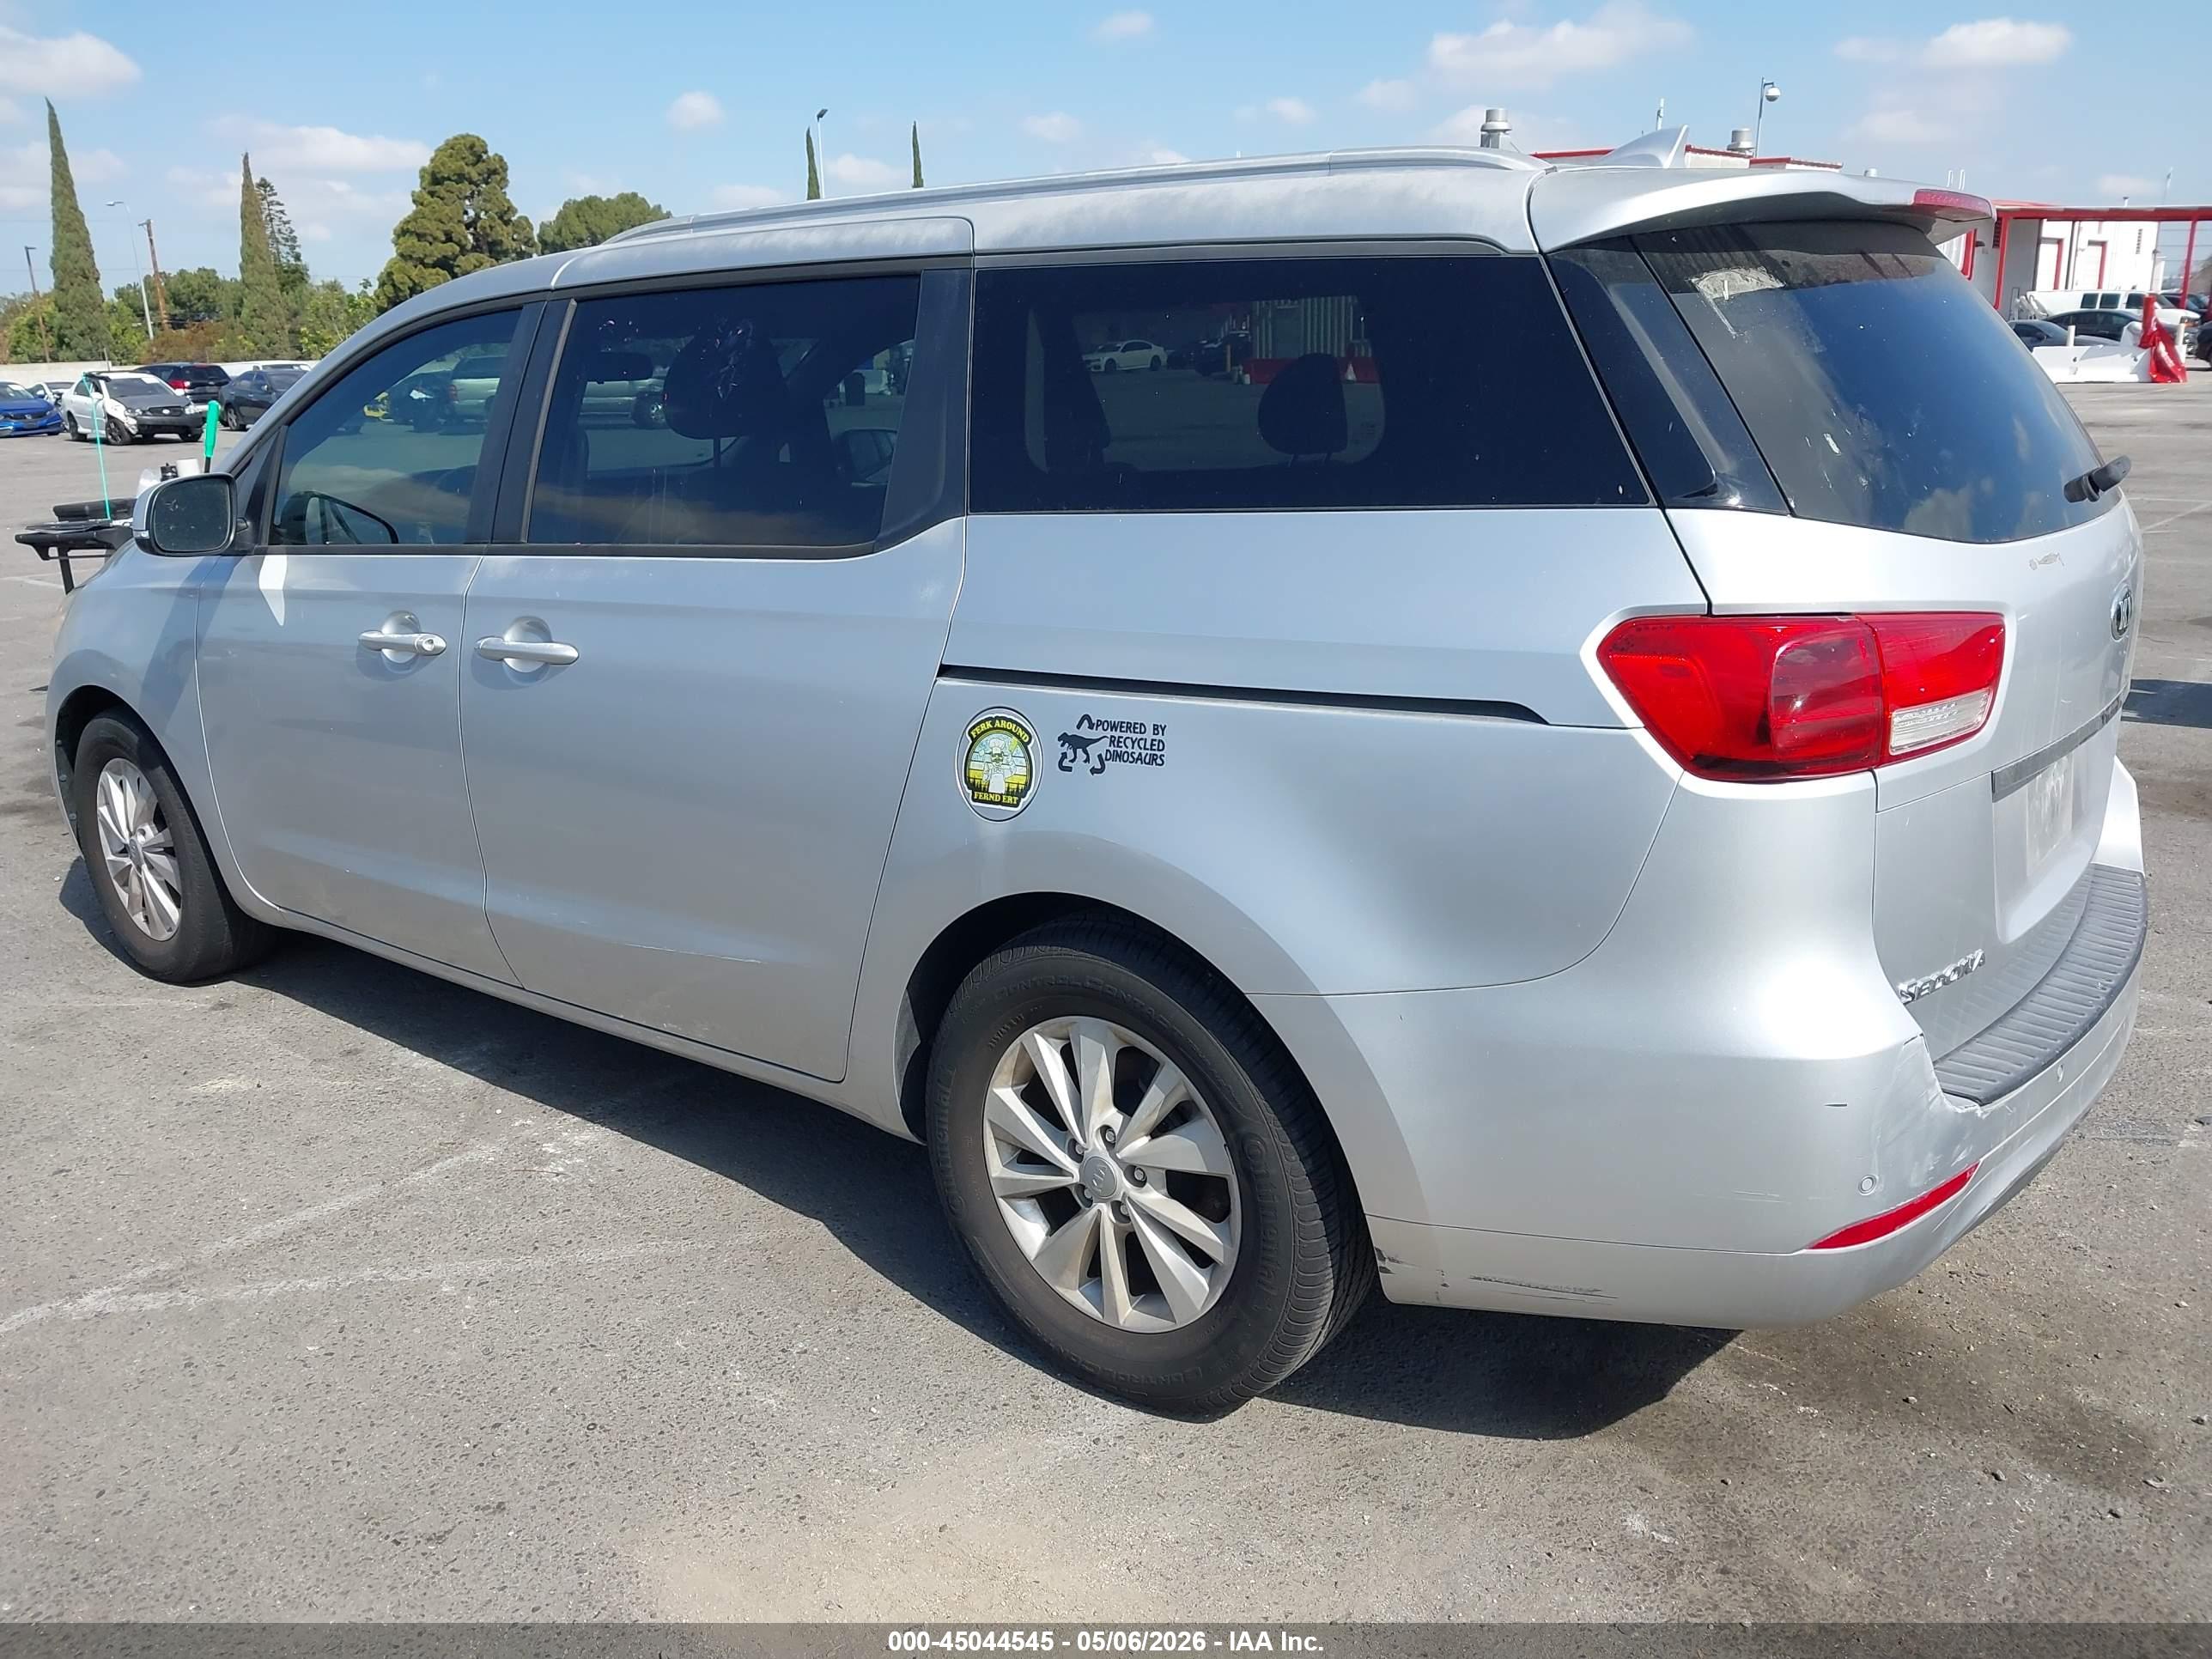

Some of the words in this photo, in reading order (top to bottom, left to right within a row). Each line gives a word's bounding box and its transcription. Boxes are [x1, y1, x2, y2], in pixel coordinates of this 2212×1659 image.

[971, 720, 993, 738] FERK
[994, 720, 1030, 743] AROUND
[1095, 719, 1146, 735] POWERED
[1152, 723, 1167, 737] BY
[1109, 734, 1165, 752] RECYCLED
[1104, 749, 1165, 767] DINOSAURS
[974, 791, 1001, 802] FERND
[1002, 795, 1018, 805] ERT
[1898, 949, 1985, 1006] SEDONA
